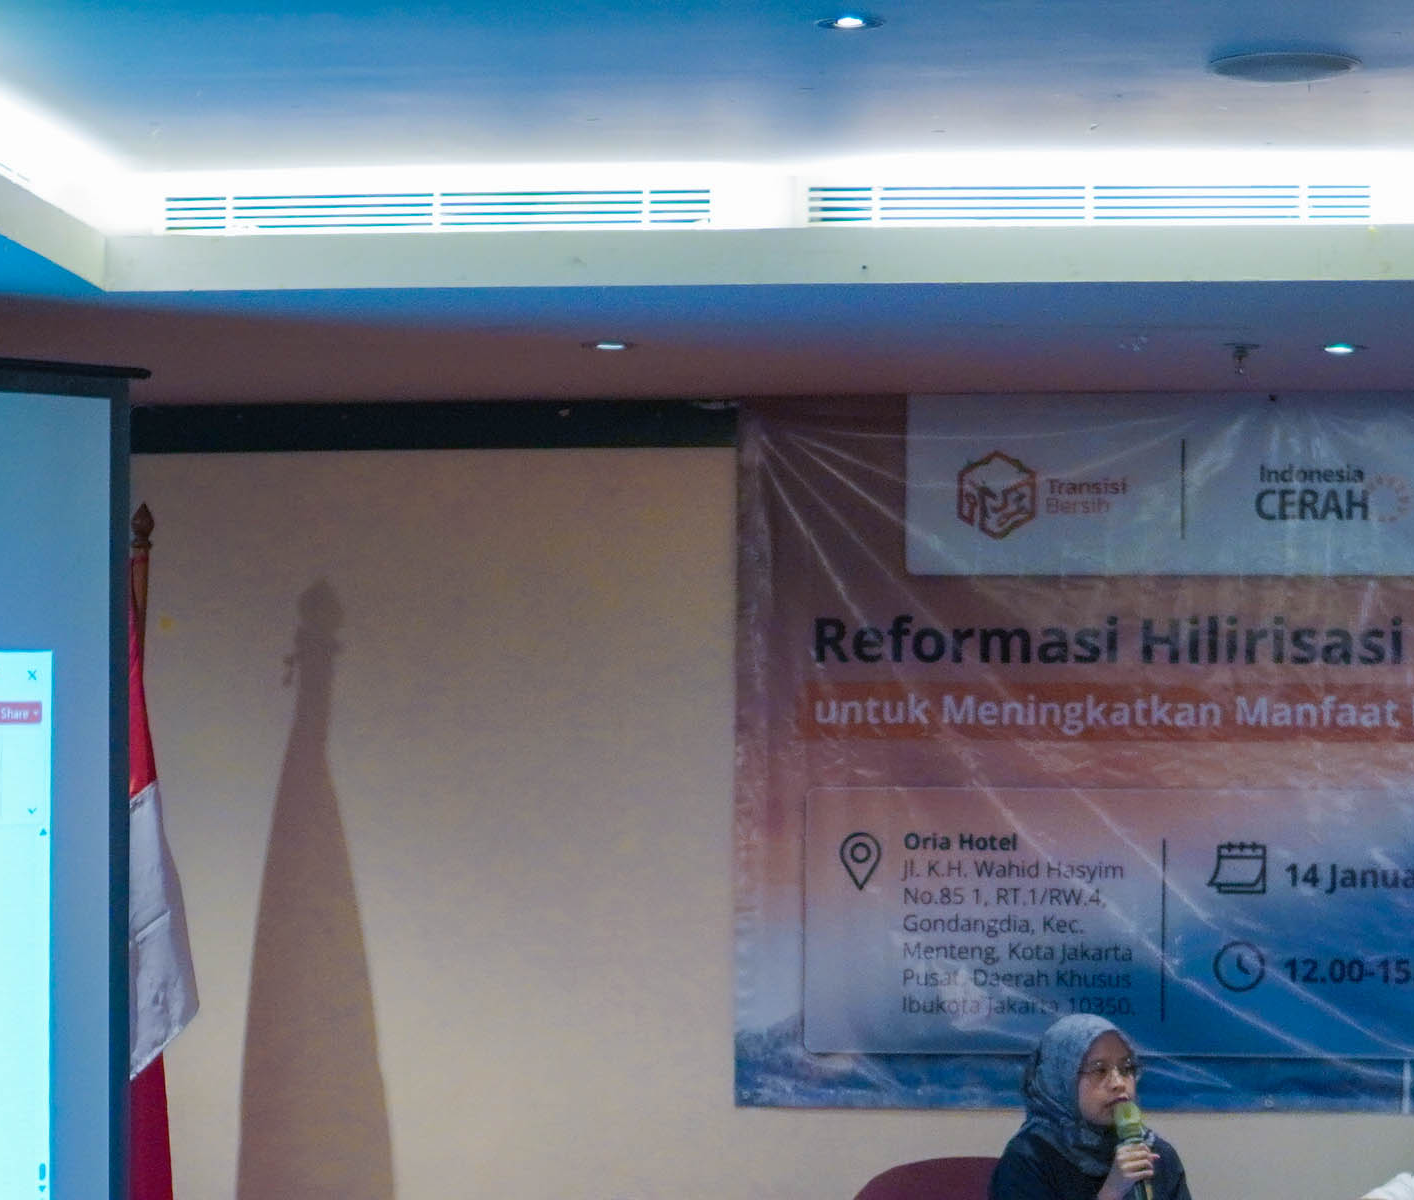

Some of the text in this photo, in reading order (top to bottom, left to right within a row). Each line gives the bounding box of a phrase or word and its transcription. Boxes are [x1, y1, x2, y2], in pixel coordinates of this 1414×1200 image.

[1259, 463, 1365, 484] Indonesia
[1046, 477, 1128, 496] Transisi
[1046, 497, 1110, 515] Bersih
[1254, 489, 1371, 522] CERAH
[813, 615, 1118, 666] Reformasi
[1142, 616, 1405, 666] Hilirisasi
[0, 705, 31, 721] Share
[814, 693, 930, 728] untuk
[942, 693, 1222, 736] Meningkatkan
[1236, 694, 1400, 730] Manfaat
[903, 832, 1019, 852] Oria Hotel
[900, 859, 1125, 884] Jl. K.H. Wahid Hasyim
[1285, 862, 1320, 888] 14
[903, 887, 965, 906] No.85
[902, 913, 1085, 938] Gondangdia, Kec.
[902, 942, 1134, 966] Menteng, Kota Jakarta
[973, 968, 1050, 989] Daerah
[1055, 968, 1133, 990] Khusus
[902, 995, 980, 1016] Ibukota
